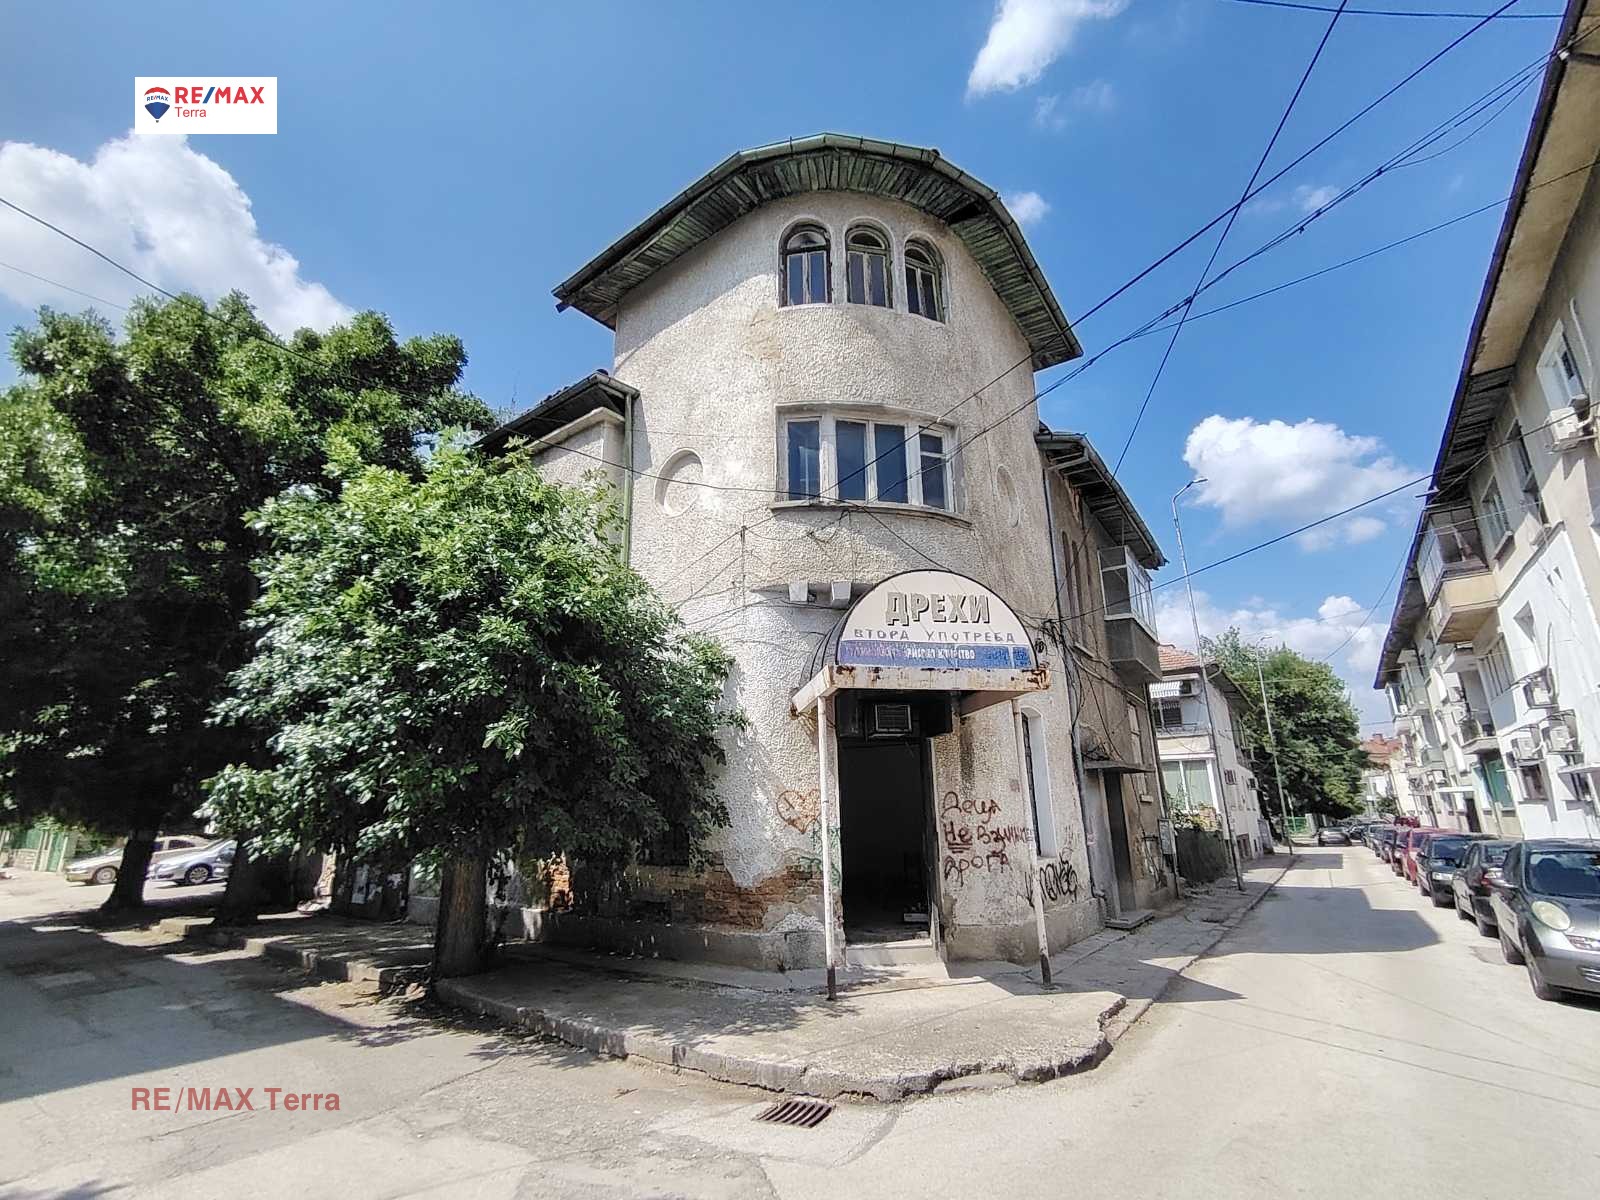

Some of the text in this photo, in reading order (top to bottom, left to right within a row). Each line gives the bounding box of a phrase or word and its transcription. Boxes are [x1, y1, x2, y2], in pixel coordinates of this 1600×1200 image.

[887, 592, 991, 626] ДРЕХИ
[854, 629, 1016, 643] ВТОРА УПОТРЕБА
